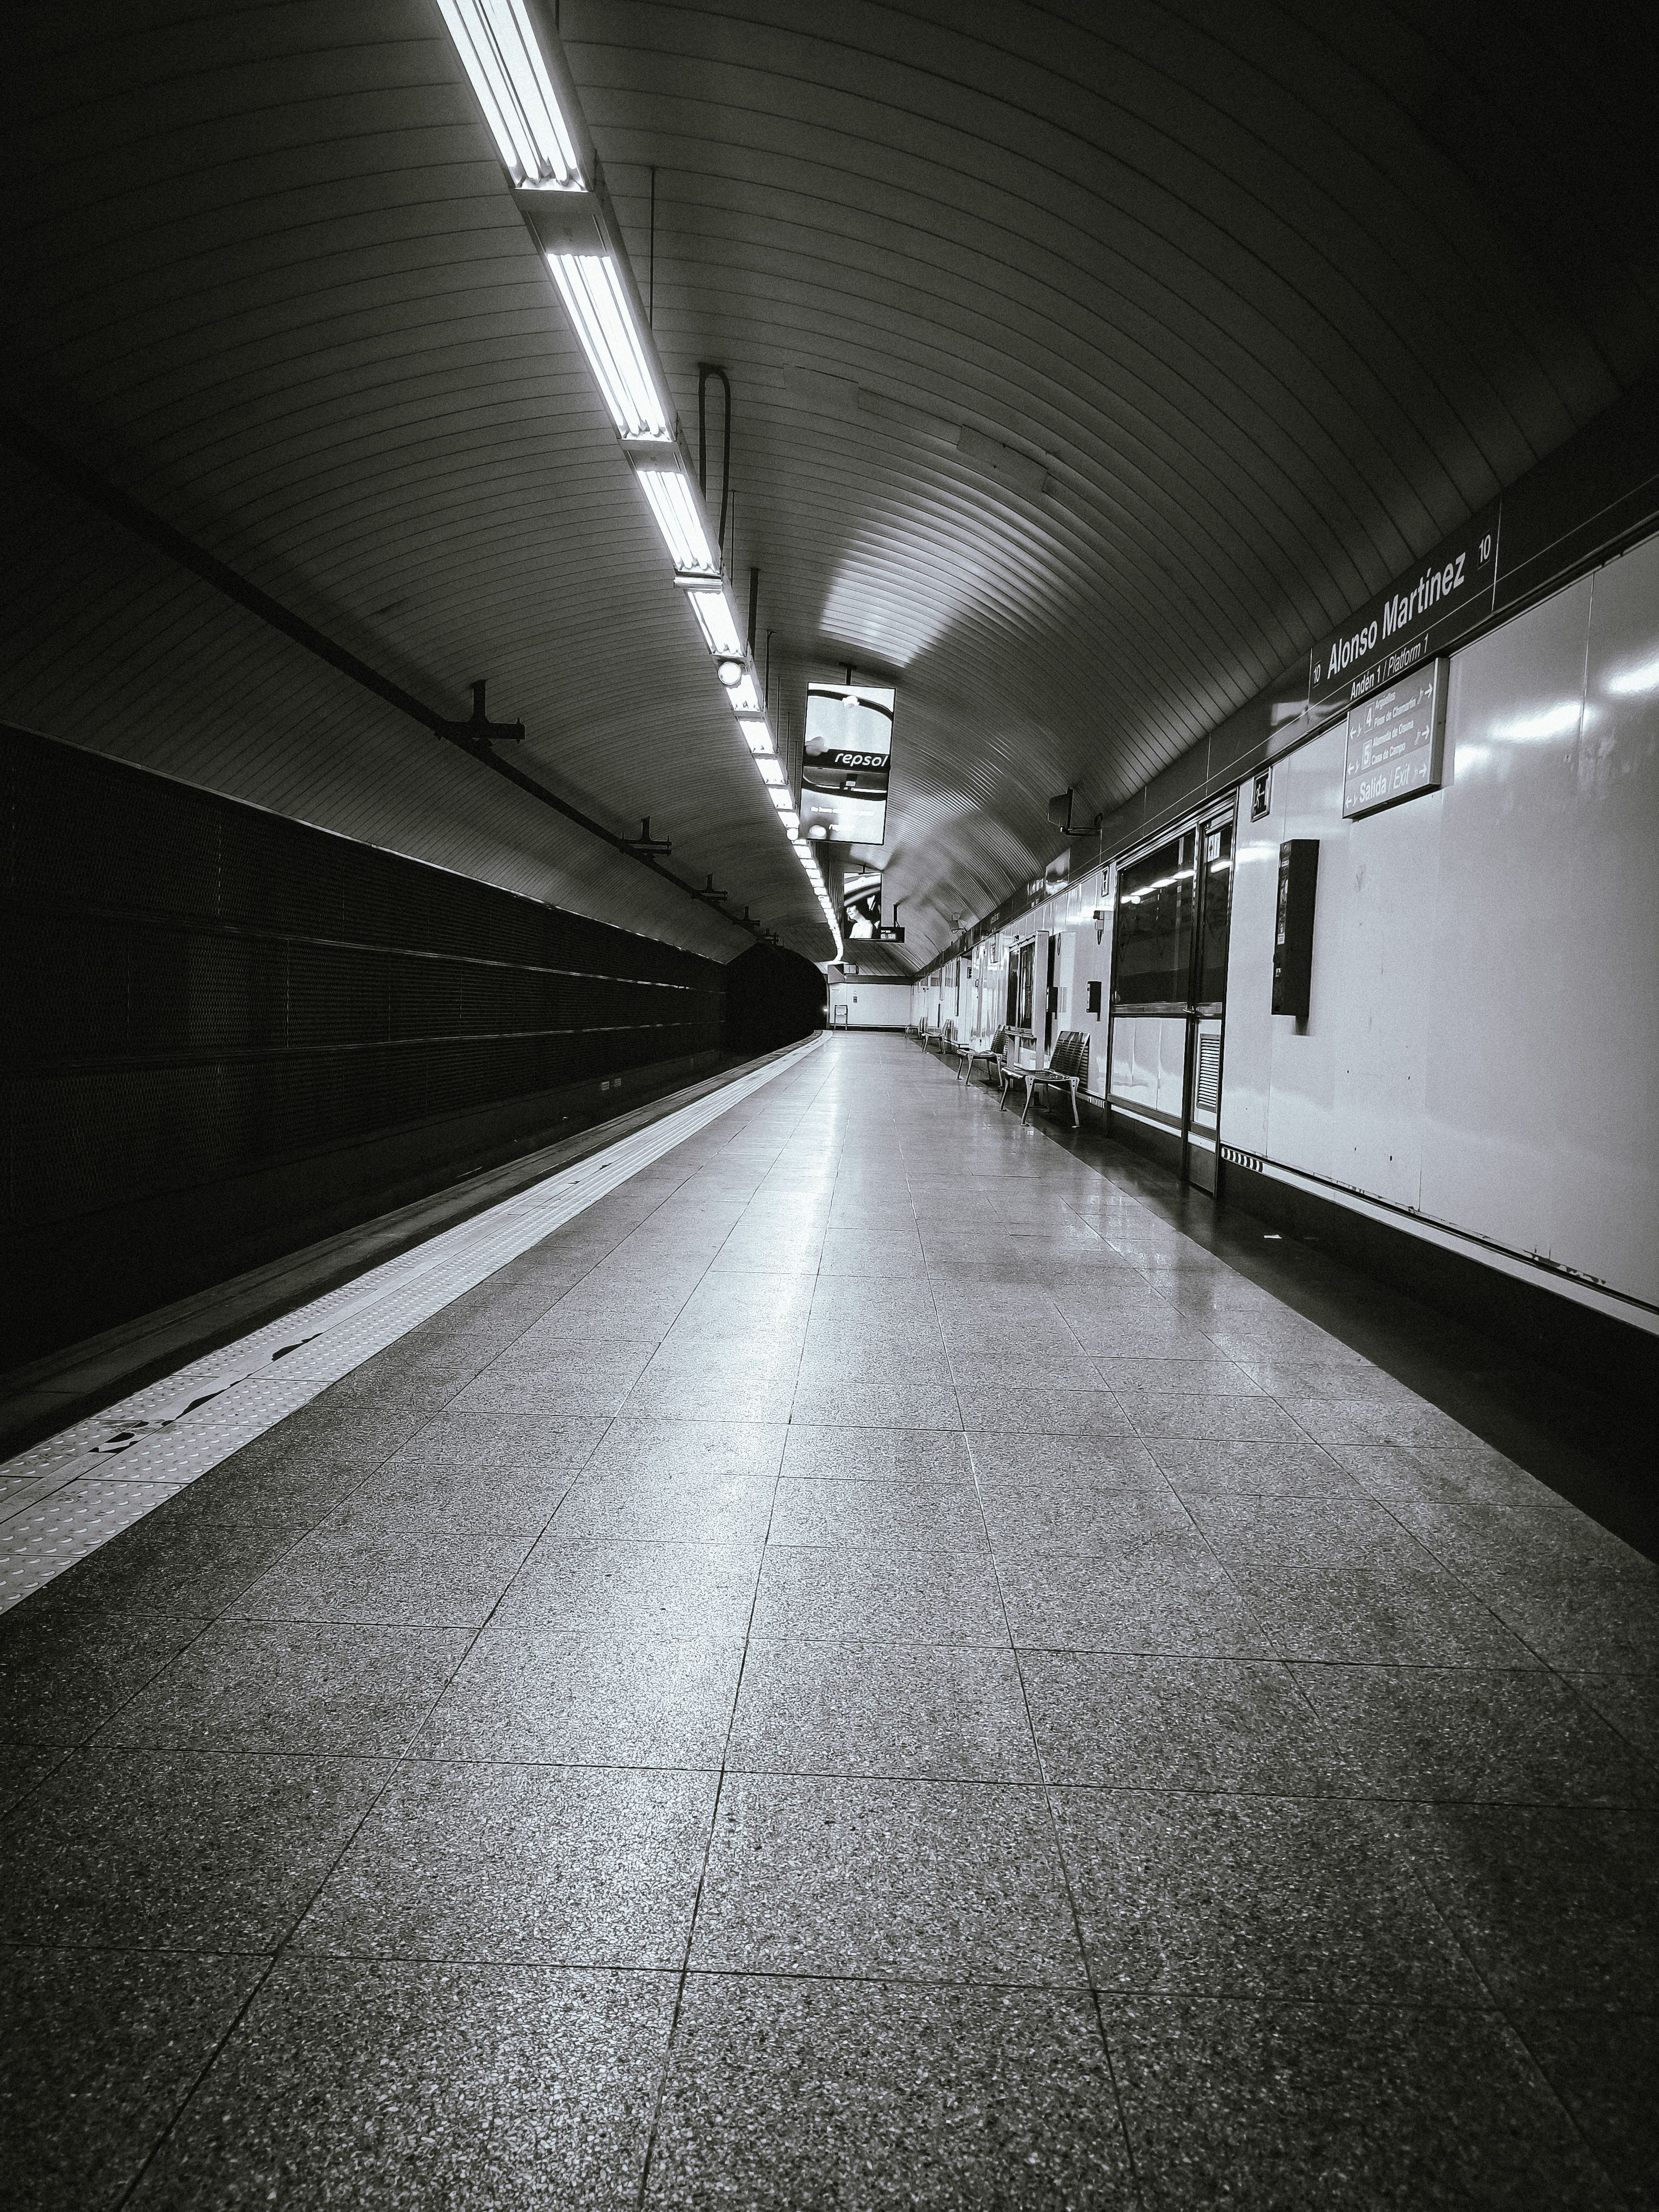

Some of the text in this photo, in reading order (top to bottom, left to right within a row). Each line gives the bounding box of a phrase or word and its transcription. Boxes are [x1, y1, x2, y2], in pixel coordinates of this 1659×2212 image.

[1313, 534, 1491, 684] 10 Alonso Martínez 10
[1350, 671, 1374, 700] Andén
[1377, 665, 1381, 683] 1
[1387, 643, 1421, 677] Platform
[1424, 632, 1429, 654] 1
[1366, 707, 1372, 727] 4
[834, 753, 889, 767] repsol
[1364, 745, 1370, 765] 5
[1359, 774, 1387, 803] Salida
[1393, 763, 1410, 790] Exit
